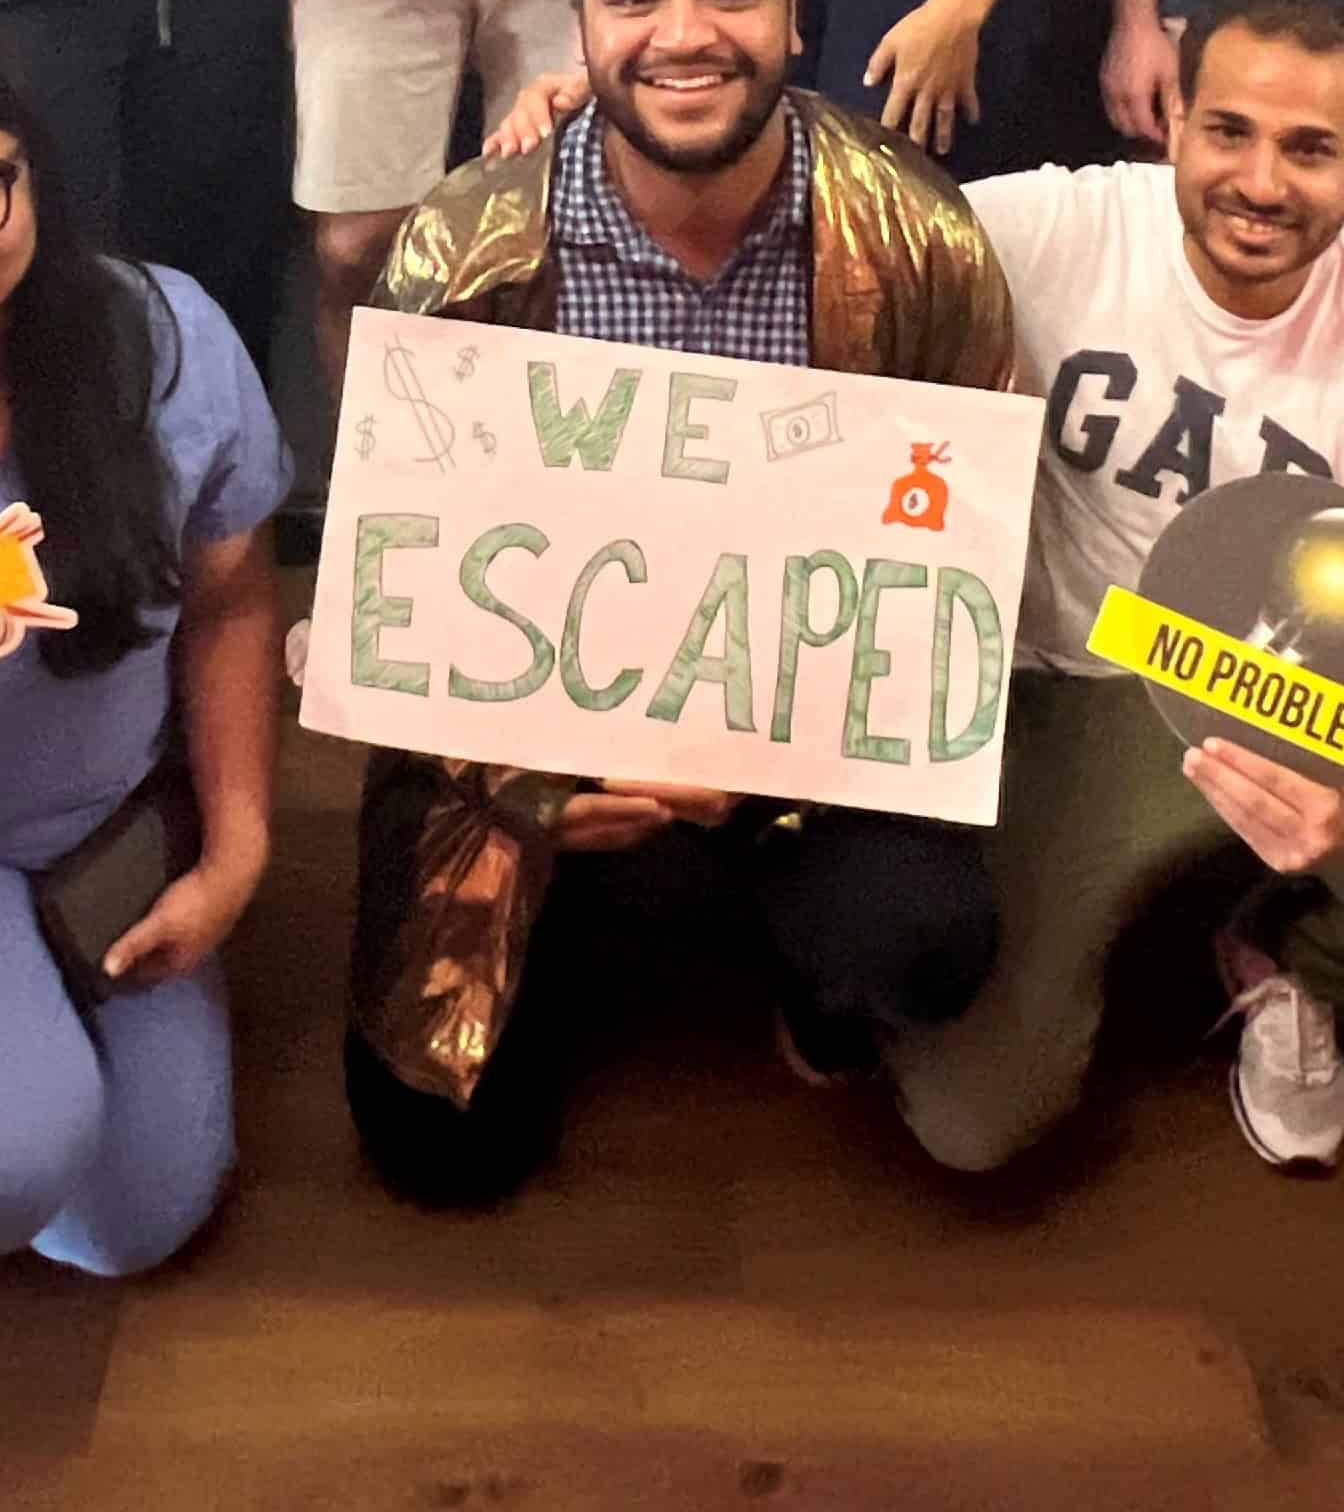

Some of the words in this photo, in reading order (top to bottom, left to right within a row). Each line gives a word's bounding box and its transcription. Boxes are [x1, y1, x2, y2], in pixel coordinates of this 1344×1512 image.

[525, 360, 739, 485] WE
[350, 511, 1005, 766] ESCAPED
[1147, 623, 1204, 680] NO
